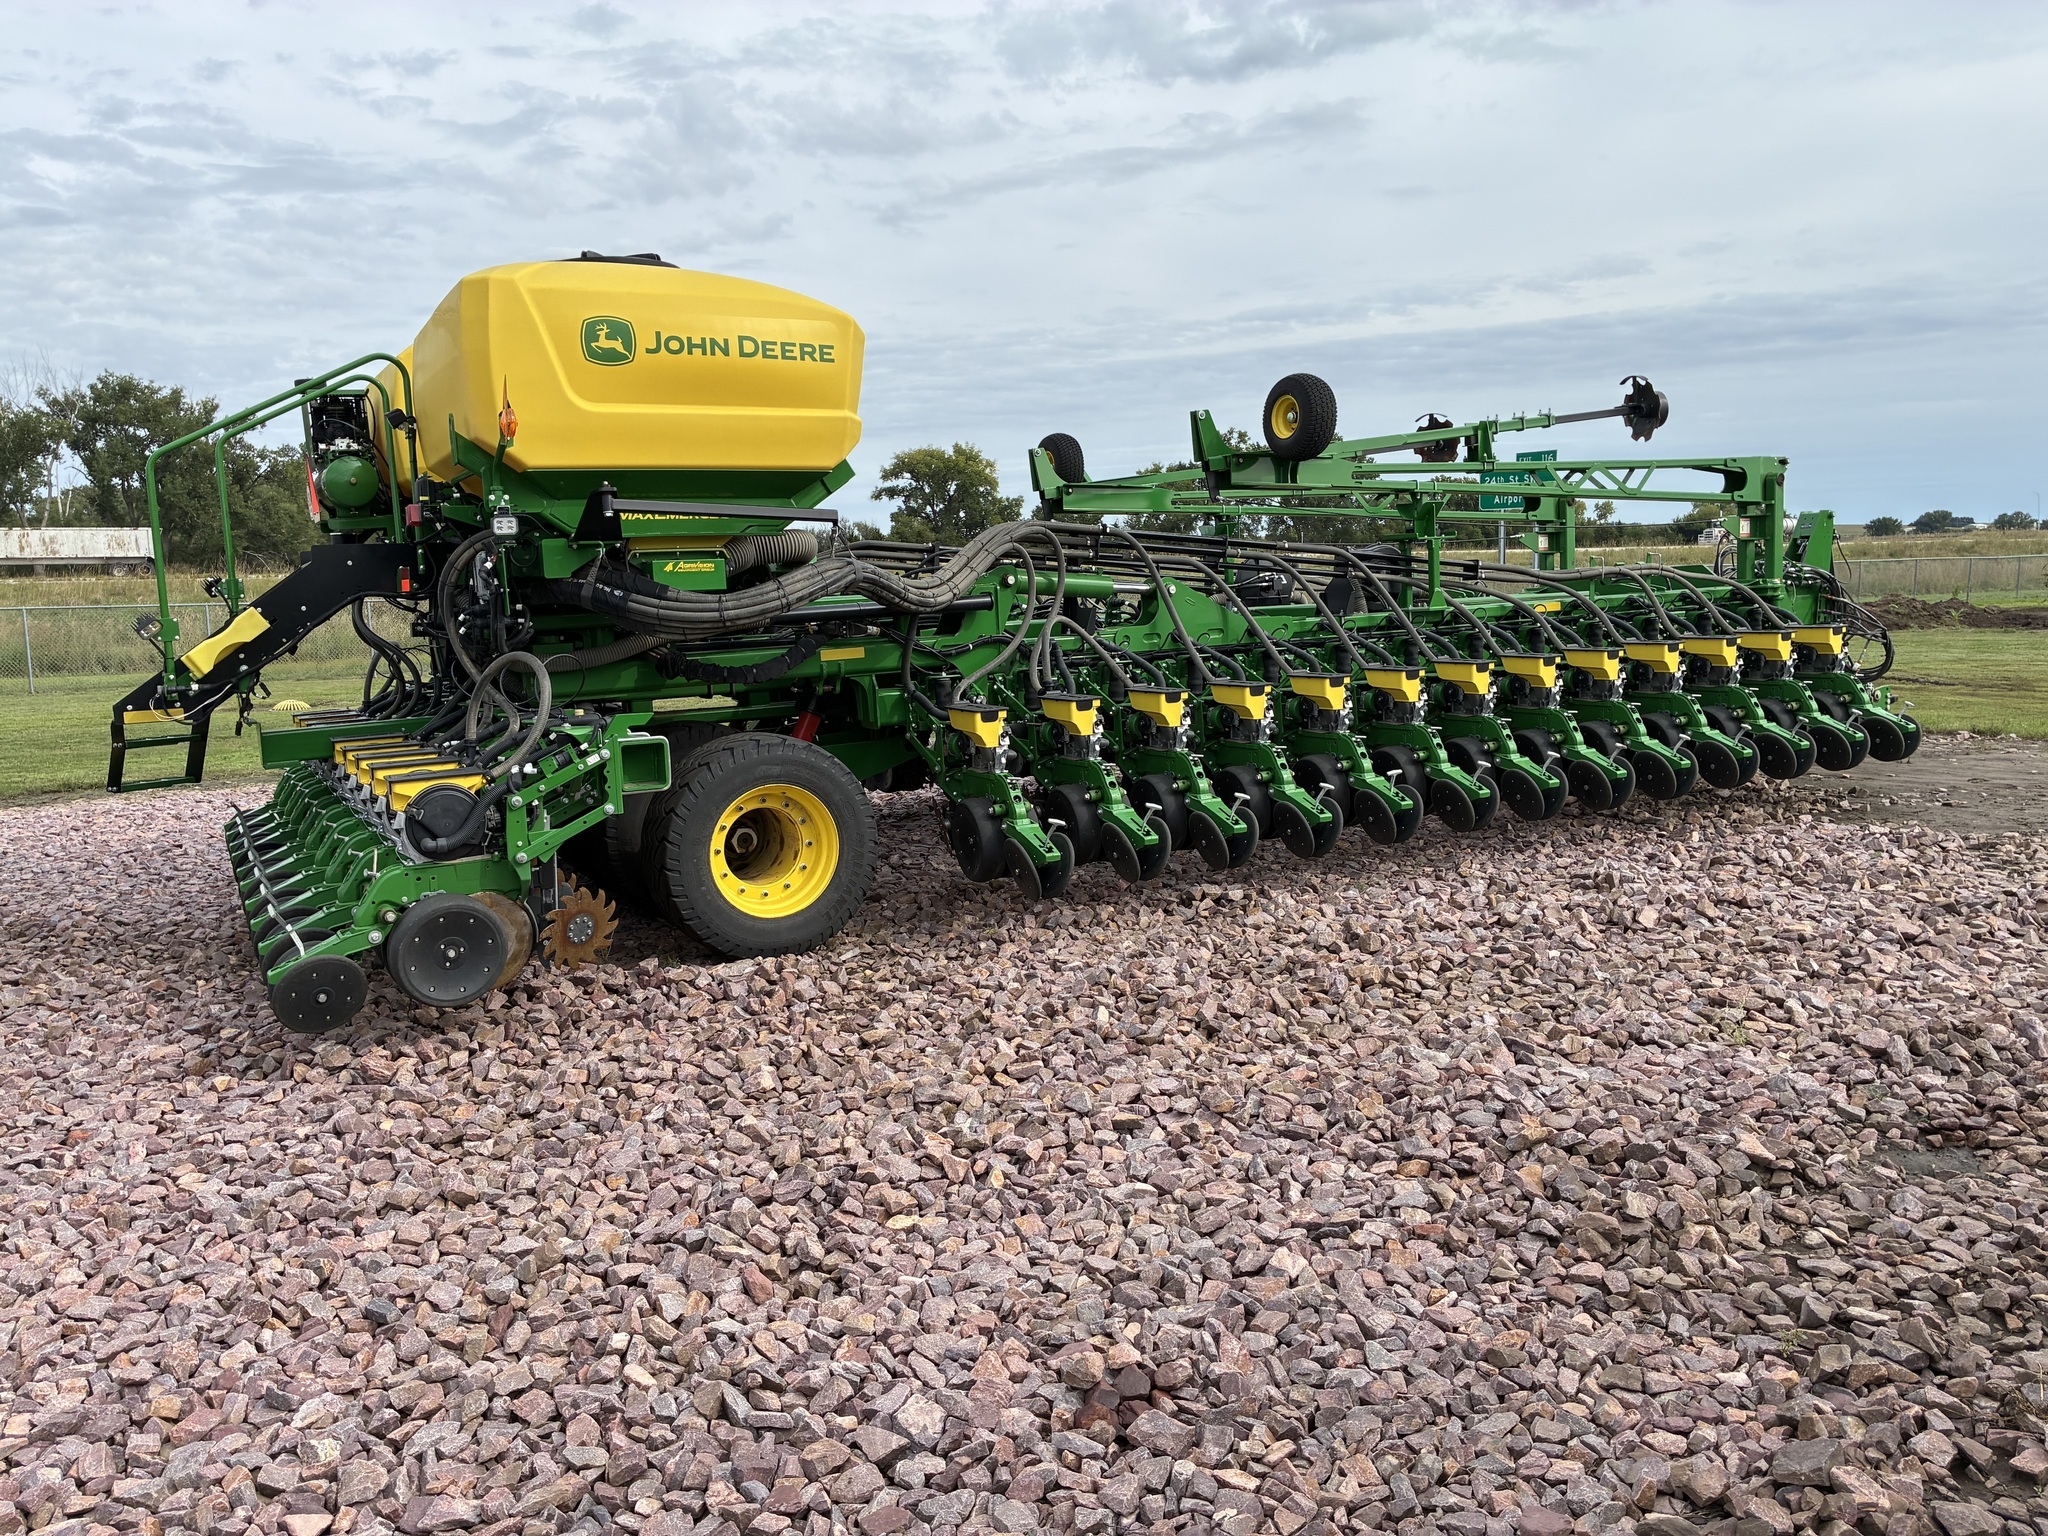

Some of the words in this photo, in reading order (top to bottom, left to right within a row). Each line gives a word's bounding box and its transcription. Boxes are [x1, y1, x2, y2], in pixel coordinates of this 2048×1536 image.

[645, 330, 730, 357] JOHN
[737, 335, 835, 363] DEERE
[1542, 454, 1553, 462] 116
[1484, 476, 1505, 484] 24th
[1509, 475, 1519, 483] St
[1494, 495, 1522, 505] Airpor
